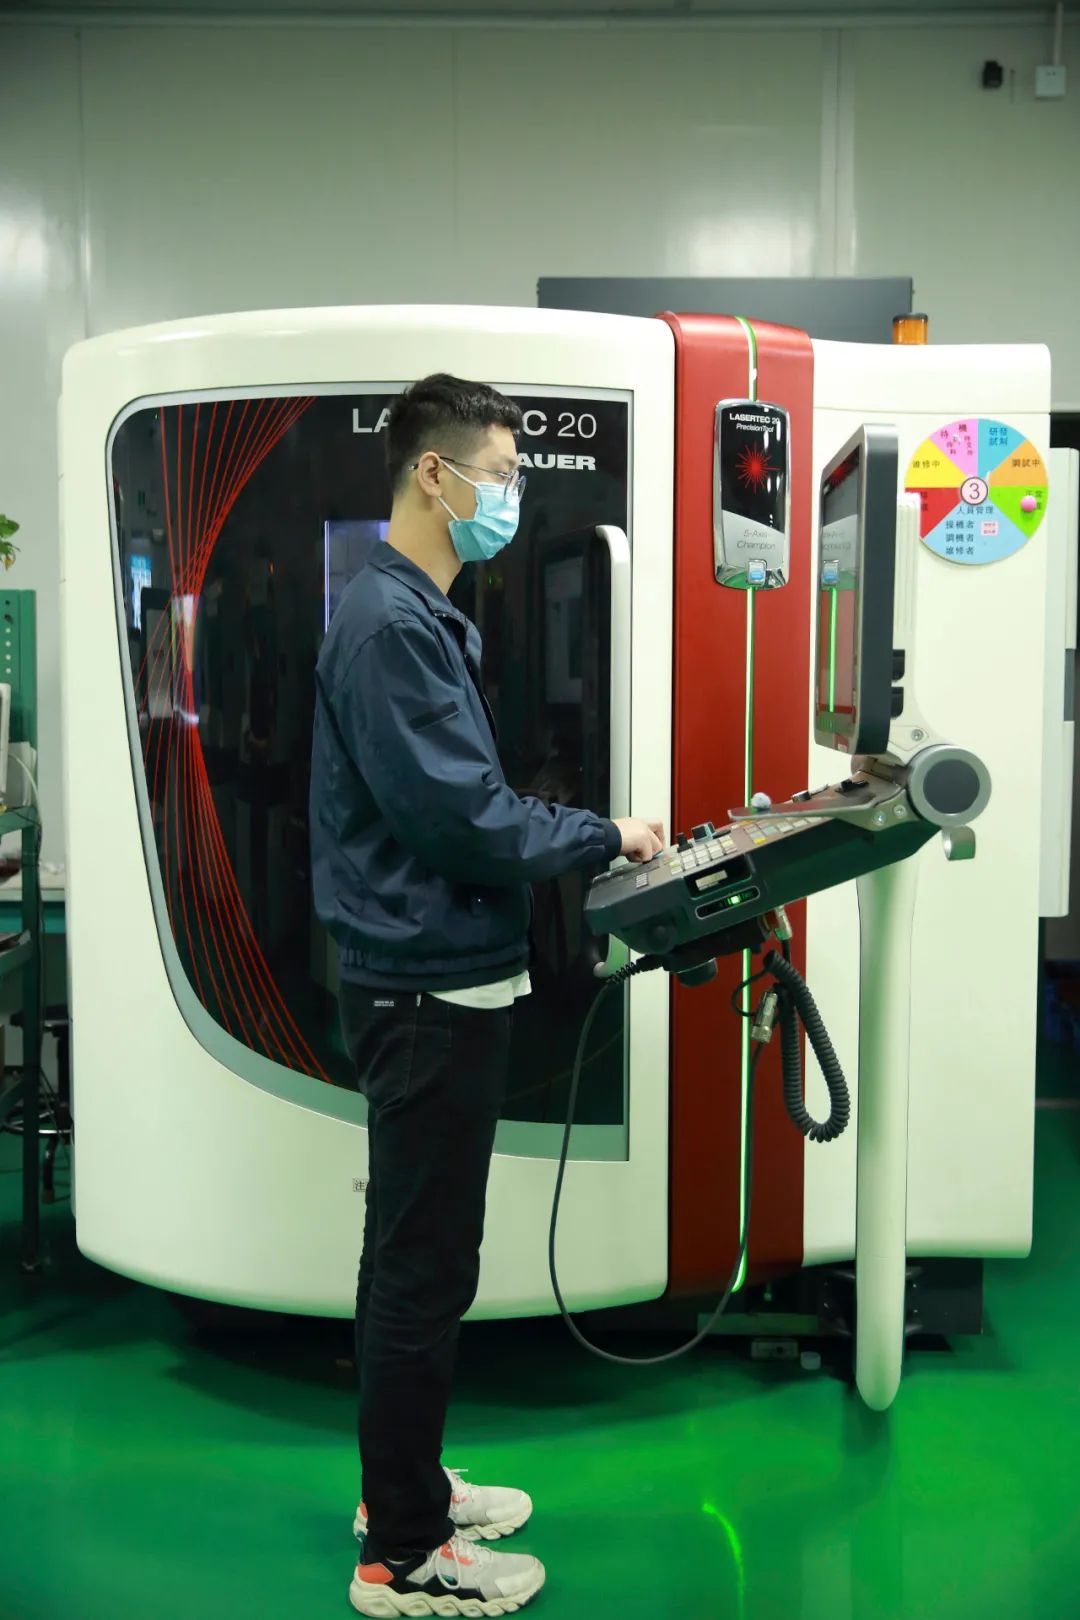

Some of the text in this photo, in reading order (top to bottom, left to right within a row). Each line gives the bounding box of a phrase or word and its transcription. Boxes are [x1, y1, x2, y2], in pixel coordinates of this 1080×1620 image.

[557, 412, 597, 439] 20
[729, 412, 771, 424] LASERTEC
[517, 452, 596, 471] AUER
[969, 482, 980, 500] 3
[736, 539, 776, 552] Champion
